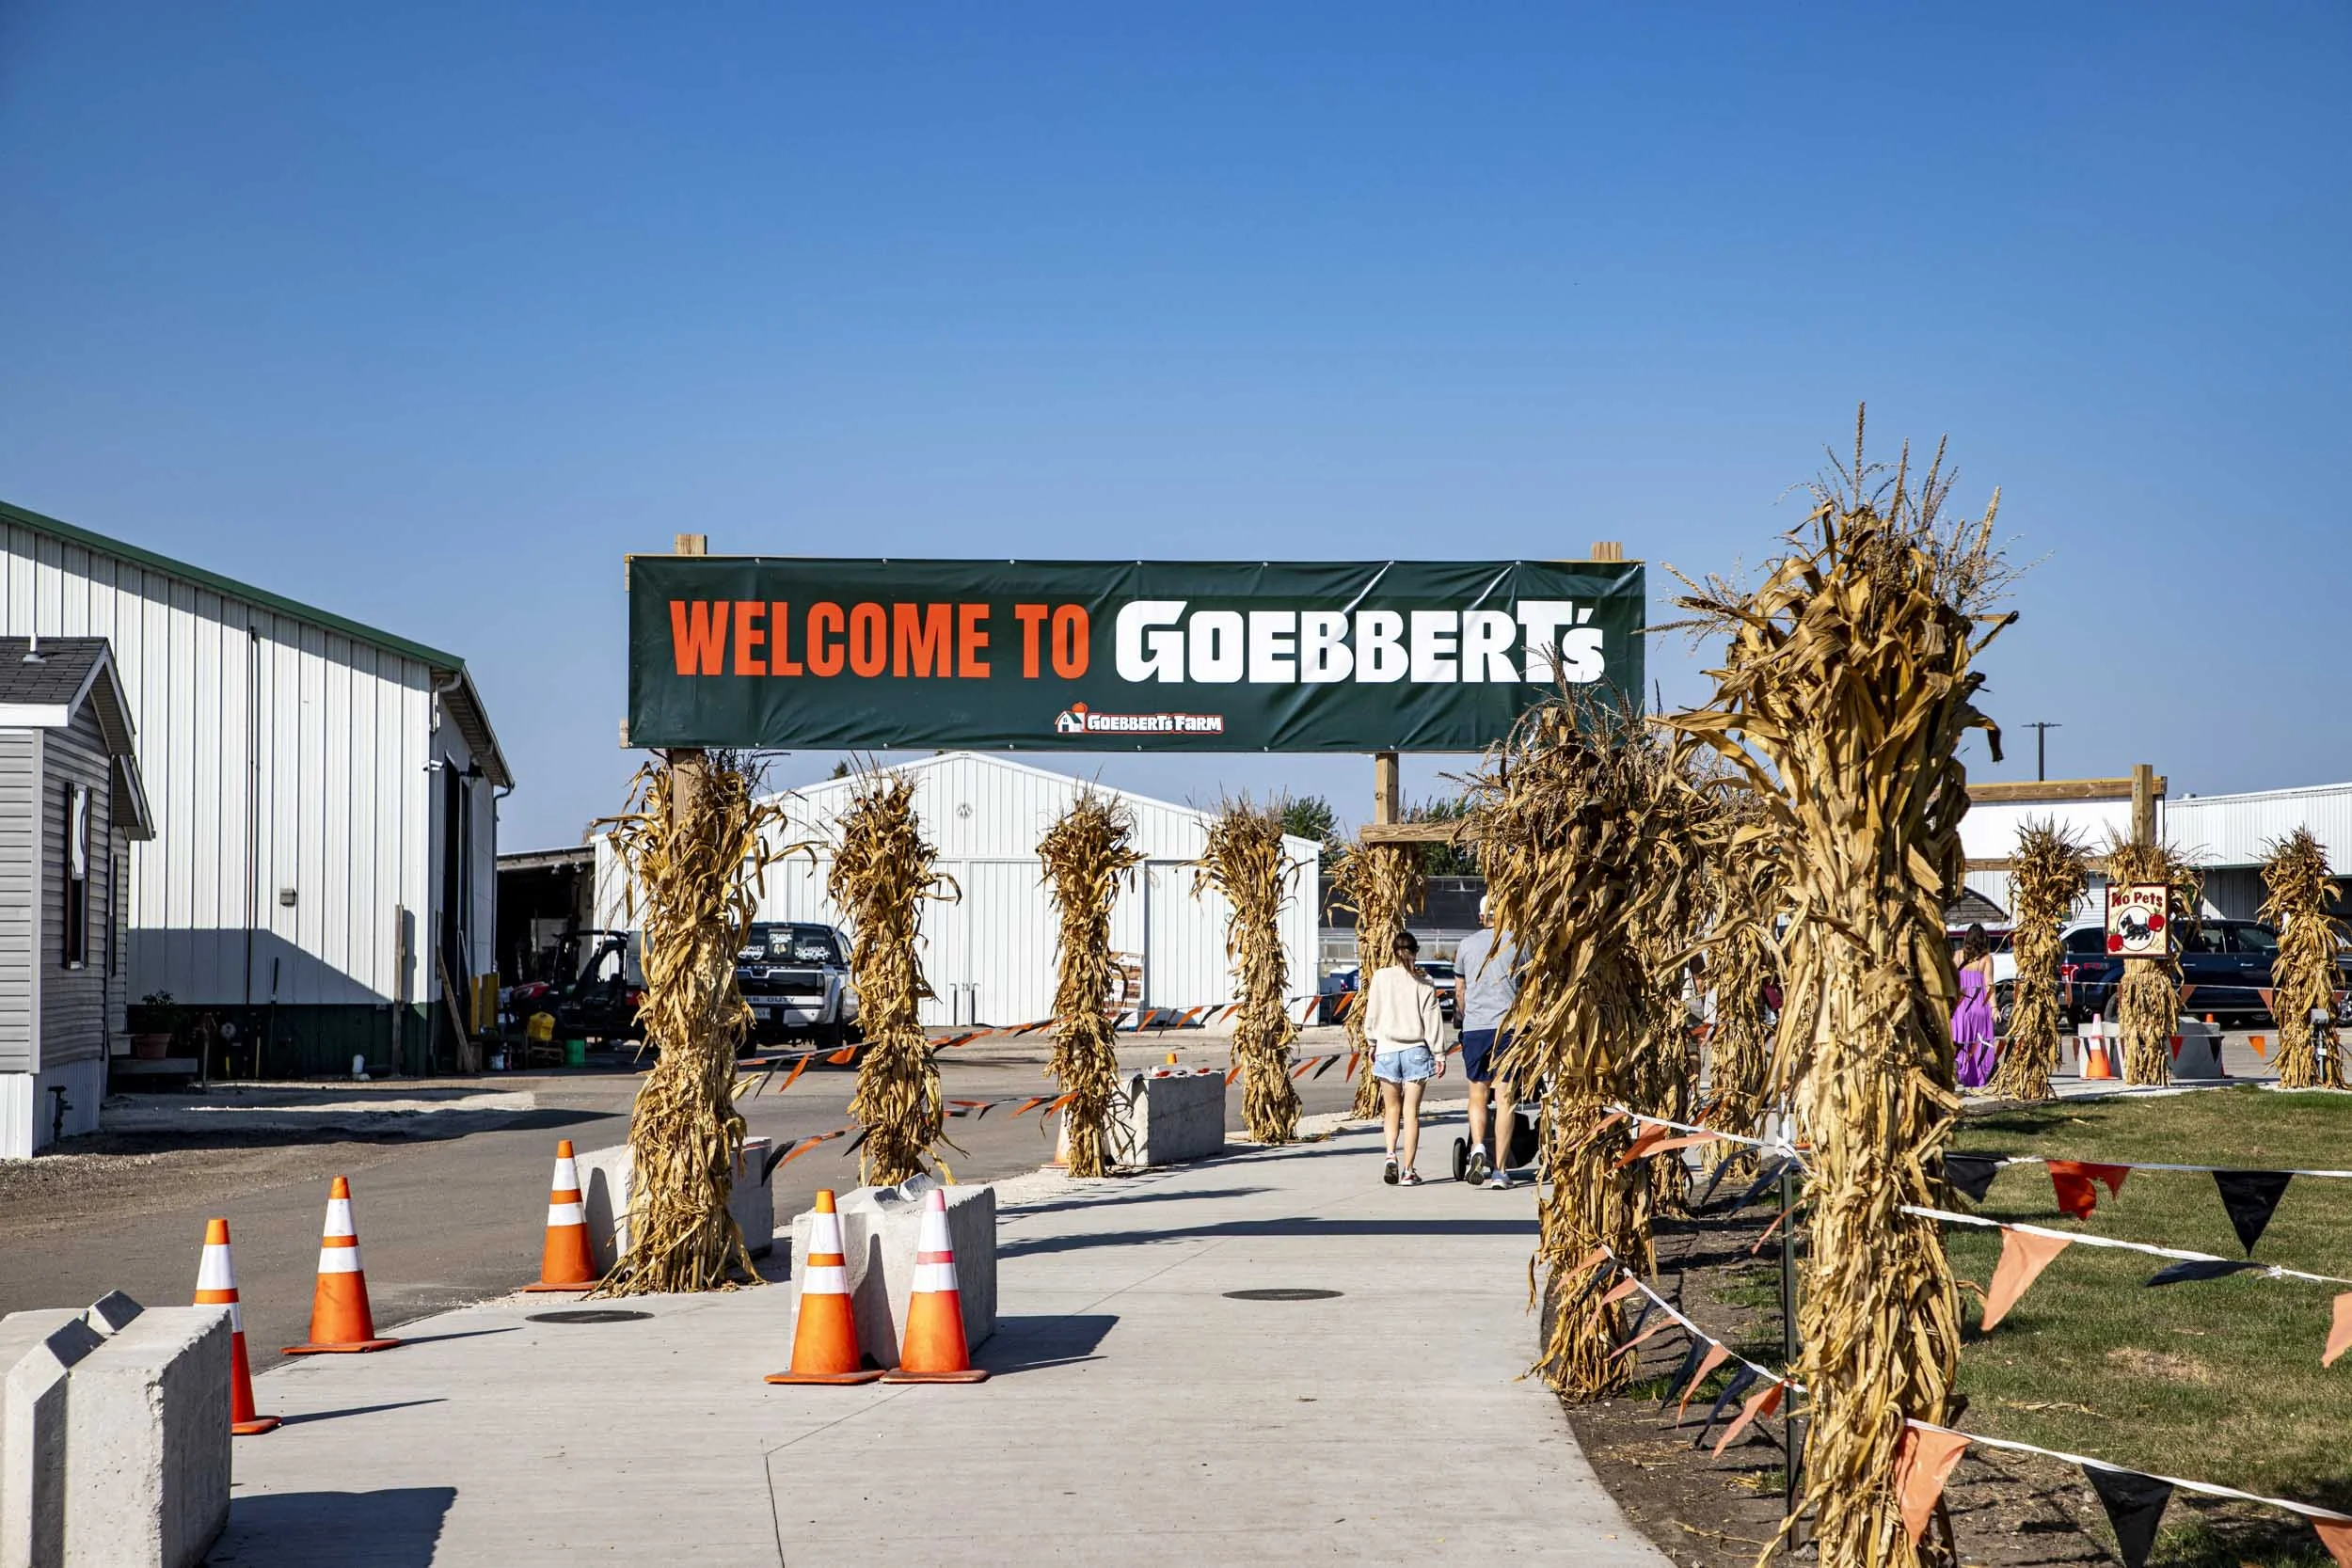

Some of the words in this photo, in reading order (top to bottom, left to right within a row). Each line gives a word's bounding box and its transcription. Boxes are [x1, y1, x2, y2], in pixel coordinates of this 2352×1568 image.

[670, 600, 991, 678] WELCOME
[1015, 603, 1089, 679] TO
[2111, 892, 2130, 907] No
[2134, 892, 2163, 907] Pets
